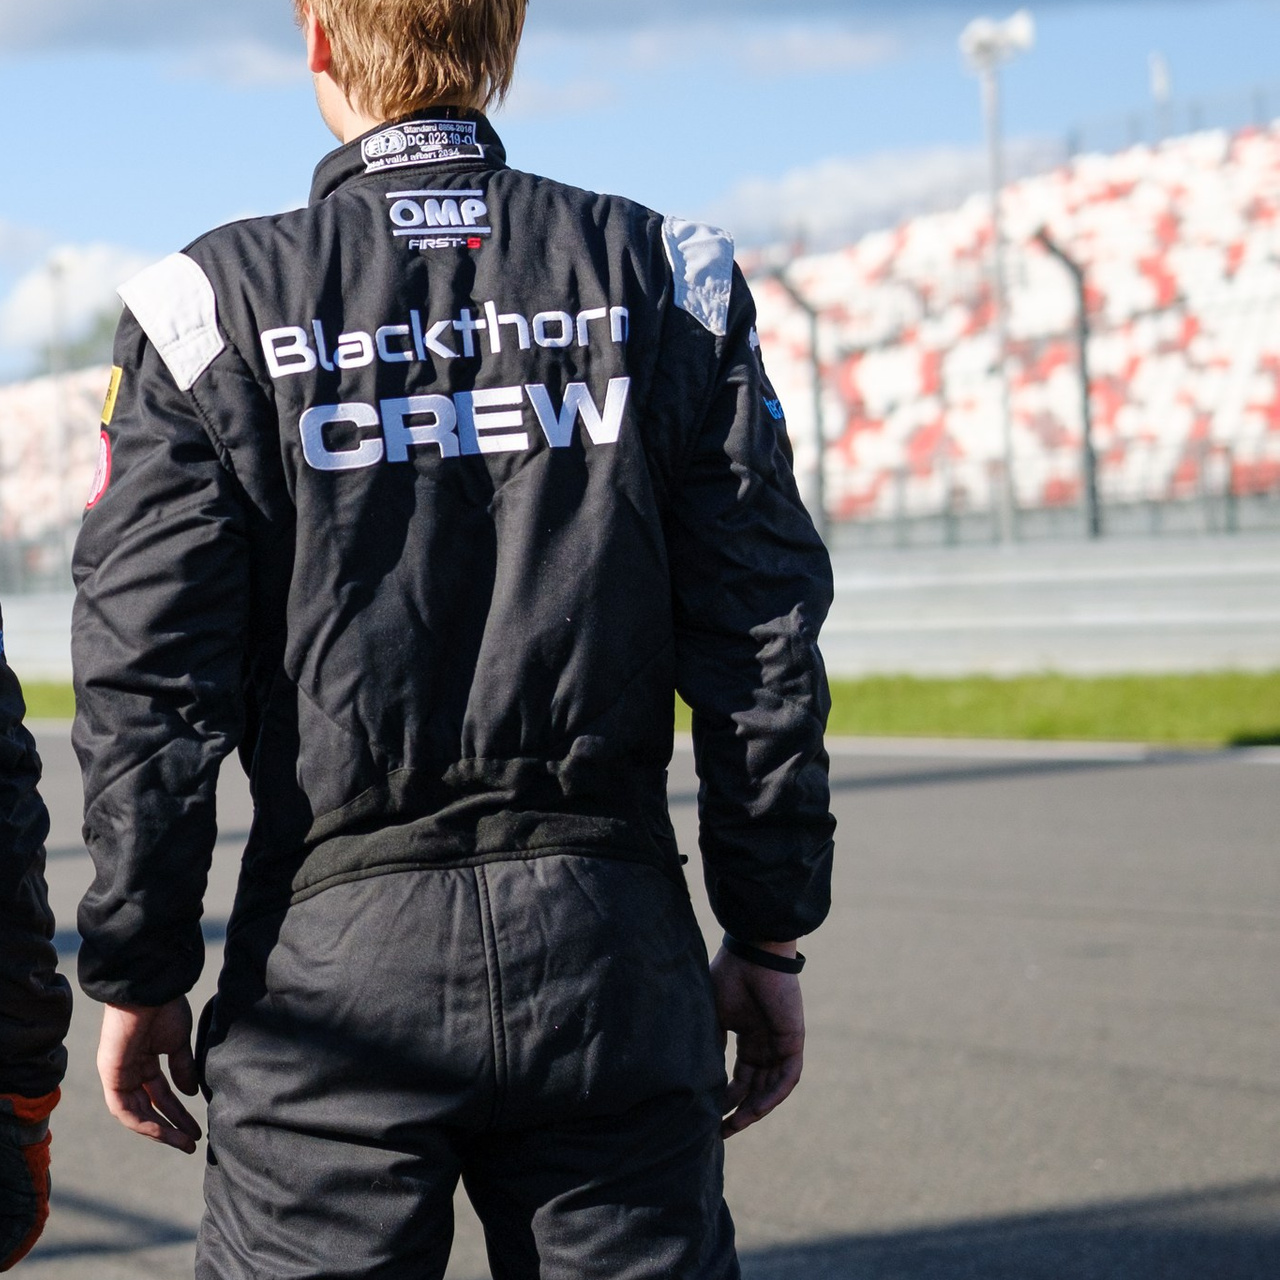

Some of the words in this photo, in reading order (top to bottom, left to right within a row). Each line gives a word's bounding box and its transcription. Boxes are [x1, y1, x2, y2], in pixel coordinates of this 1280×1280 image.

[403, 124, 437, 133] Standard
[385, 153, 408, 165] valid
[389, 198, 487, 227] OMP
[408, 236, 482, 250] FIRST-S
[260, 300, 629, 379] Blackthorn
[298, 376, 631, 471] CREW
